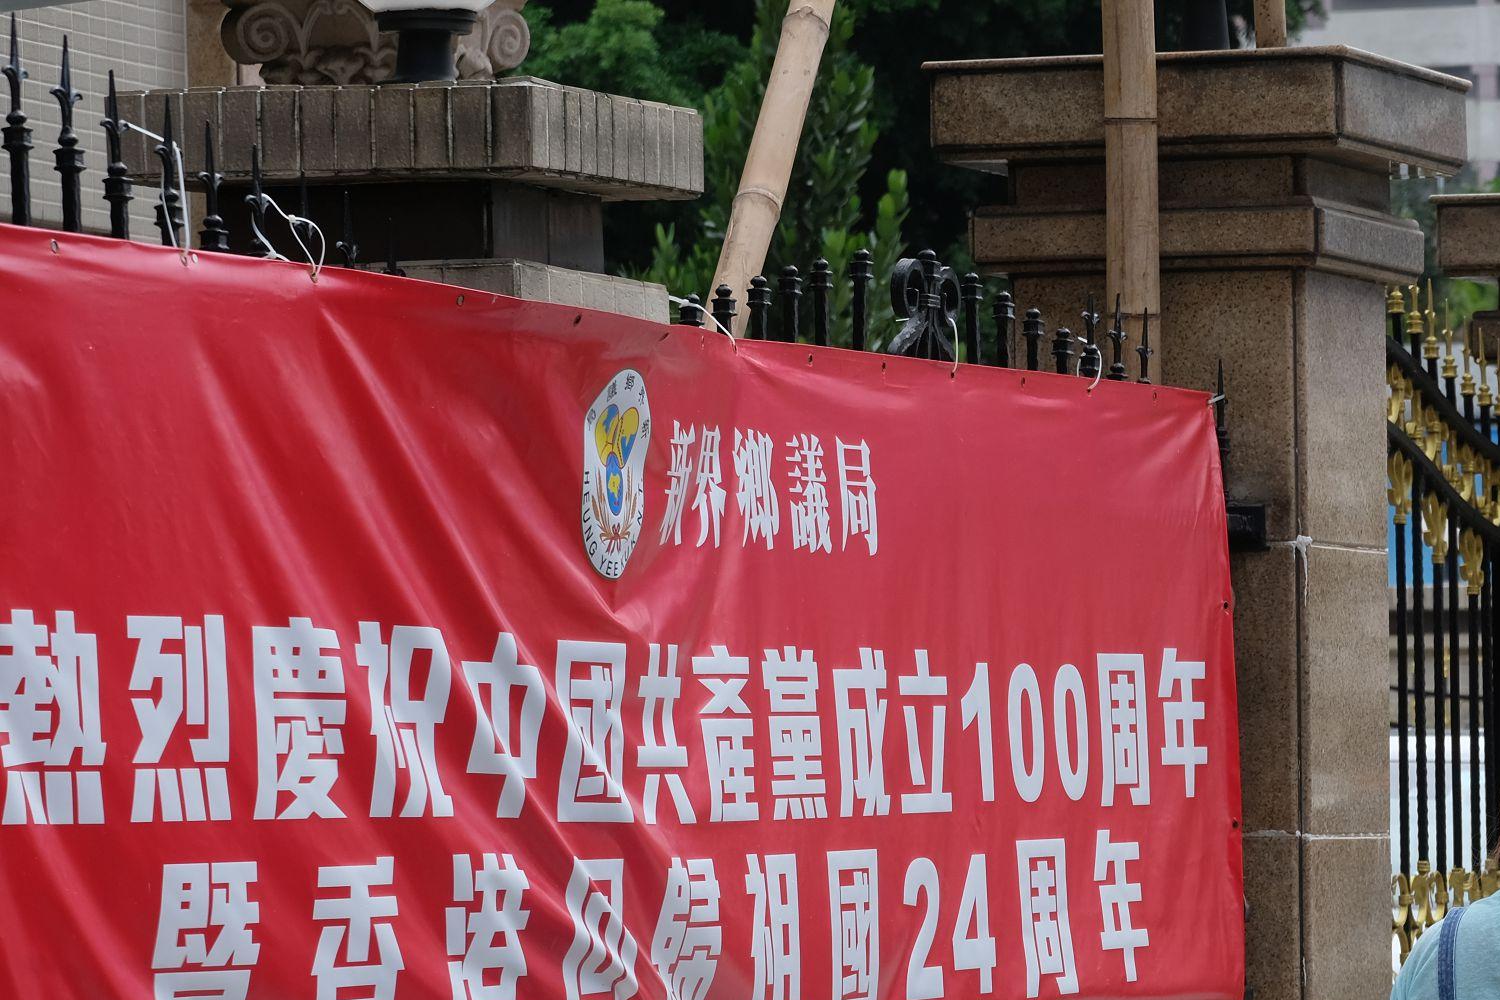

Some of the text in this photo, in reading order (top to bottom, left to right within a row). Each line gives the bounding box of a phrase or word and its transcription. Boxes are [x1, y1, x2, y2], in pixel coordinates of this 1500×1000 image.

[583, 471, 598, 558] HEUNG
[599, 554, 619, 577] YEE
[659, 420, 879, 556] 新界鄉議局
[0, 609, 1208, 826] 熱烈慶祝中國共產黨成立100周年
